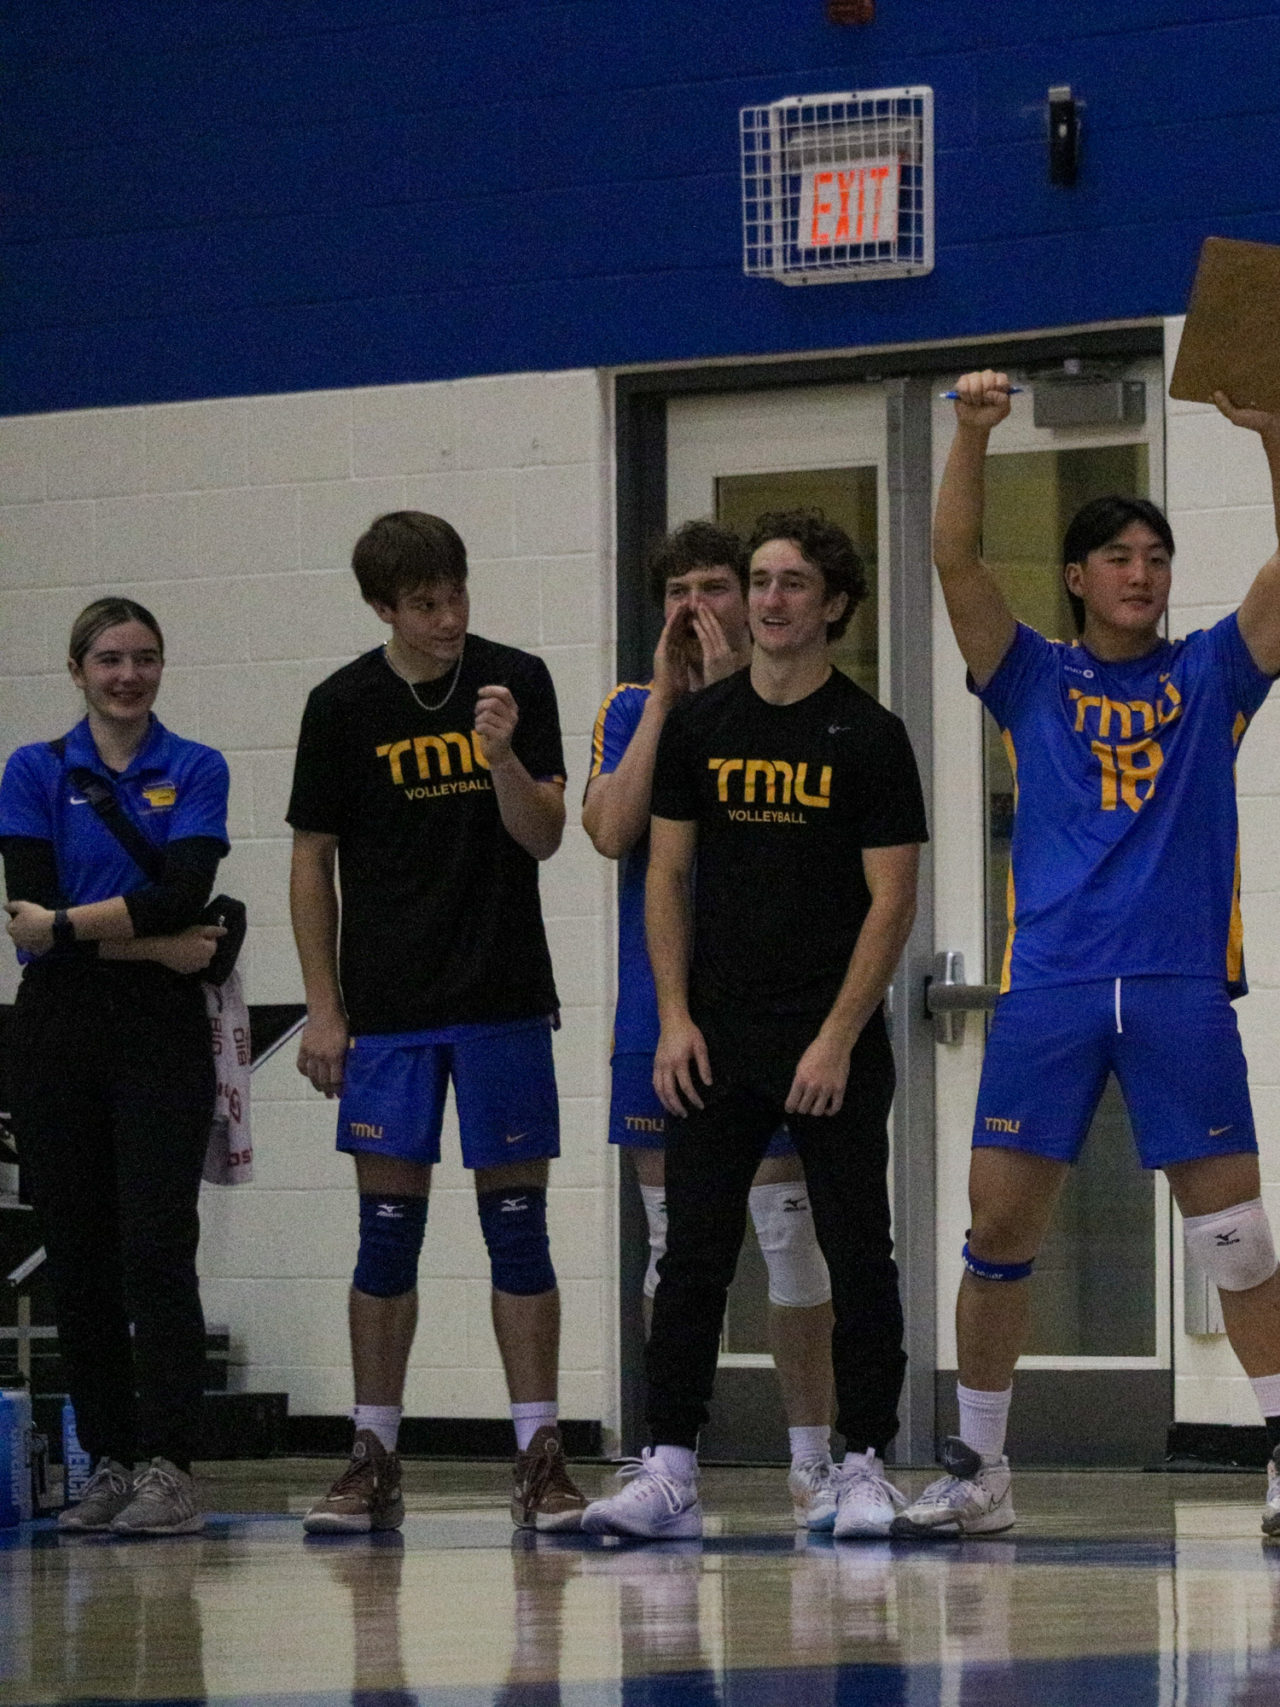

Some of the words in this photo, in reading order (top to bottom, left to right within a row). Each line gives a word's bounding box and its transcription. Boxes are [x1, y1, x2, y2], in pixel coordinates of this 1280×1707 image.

[811, 166, 888, 245] EXIT
[1068, 681, 1182, 739] TMU
[404, 778, 492, 800] VOLLEYBALL
[708, 758, 832, 808] TMU
[728, 809, 807, 824] VOLLEYBALL
[350, 1122, 383, 1139] TMU
[624, 1116, 665, 1132] TMU
[984, 1116, 1021, 1134] TMU
